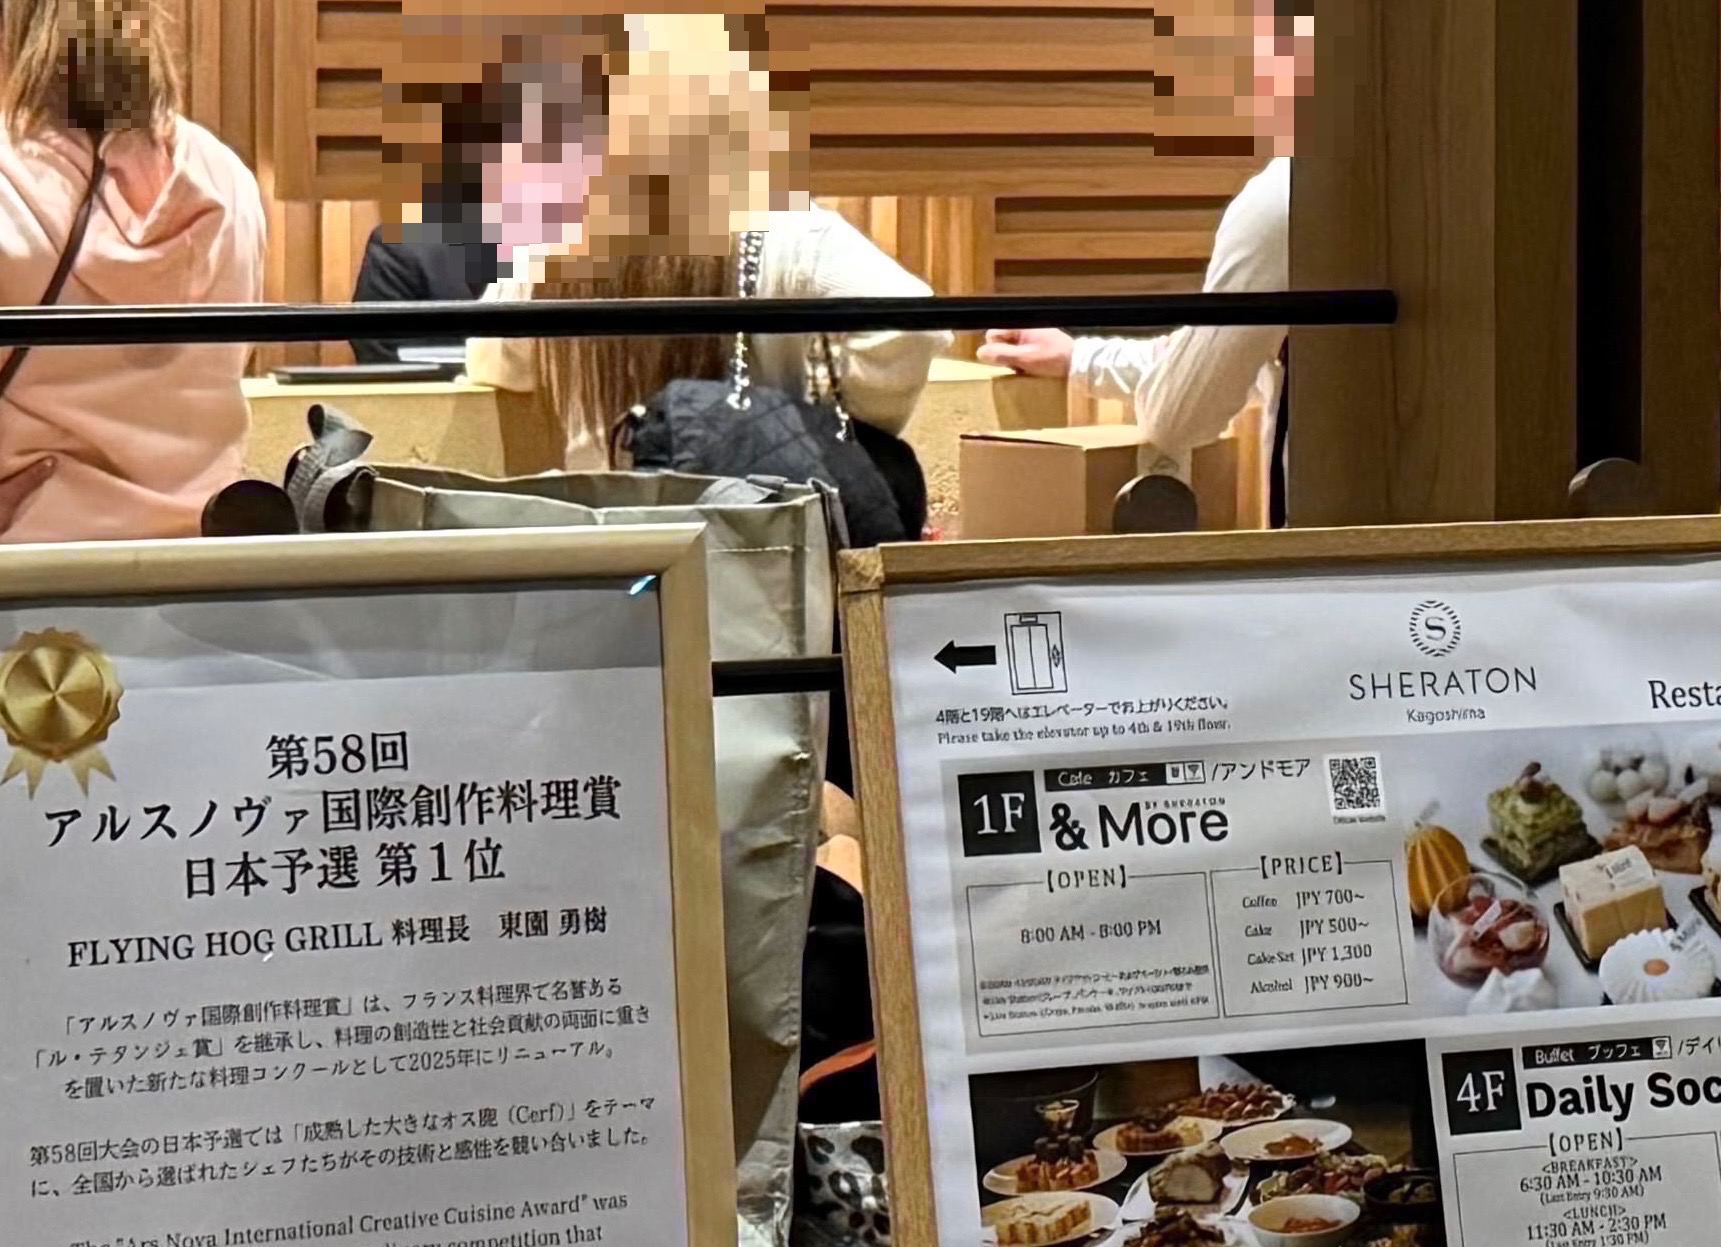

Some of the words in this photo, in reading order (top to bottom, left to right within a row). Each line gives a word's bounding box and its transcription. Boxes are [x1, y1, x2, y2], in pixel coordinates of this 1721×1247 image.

[1350, 665, 1537, 701] SHERATON
[1406, 706, 1486, 726] Kagoshima
[937, 729, 979, 745] Please
[981, 728, 1011, 742] take
[1013, 726, 1035, 741] the
[1037, 725, 1091, 739] elevator
[1093, 726, 1110, 740] up
[1112, 724, 1126, 737] to
[1128, 721, 1150, 735] 4th
[1166, 718, 1195, 733] 19th
[265, 730, 410, 780] 第58回
[1107, 768, 1150, 785] カフェ
[44, 774, 622, 848] アルスノヴァ国際創作料理賞
[972, 791, 1026, 836] 1F
[1049, 802, 1090, 851] &
[1098, 801, 1229, 849] More
[185, 843, 361, 900] 日本予選
[375, 836, 506, 888] 第1位
[1242, 894, 1278, 908] Coffee
[1296, 890, 1321, 909] JPY
[67, 933, 195, 968] FLYING
[204, 928, 275, 958] HOG
[284, 921, 383, 953] GRILL
[391, 913, 471, 947] 料理長
[558, 905, 608, 936] 勇樹
[1020, 926, 1055, 944] 8:00
[1059, 924, 1085, 942] AM
[1099, 922, 1134, 939] 8:00
[1138, 918, 1162, 937] PM
[1244, 923, 1273, 938] Cake
[1299, 919, 1325, 939] JPY
[1247, 951, 1276, 966] Cake
[1301, 946, 1327, 966] JPY
[1332, 943, 1372, 962] 1,300
[1304, 974, 1330, 994] JPY
[1534, 1048, 1575, 1065] Buffet
[1456, 1070, 1505, 1113] 4F
[1525, 1073, 1634, 1122] Daily
[1520, 1175, 1552, 1193] 6:30
[1556, 1172, 1580, 1190] AM
[1594, 1168, 1634, 1186] 10:30
[1639, 1164, 1662, 1182] AM
[167, 1233, 217, 1247] Nova
[224, 1214, 354, 1246] International
[360, 1209, 440, 1234] Creative
[443, 1202, 516, 1226] Cuisine
[593, 1193, 628, 1211] was
[1527, 1221, 1567, 1241] 11:30
[1571, 1219, 1595, 1237] AM
[1608, 1215, 1640, 1233] 2:30
[1644, 1212, 1667, 1230] PM
[448, 1228, 559, 1247] competition
[566, 1225, 603, 1243] that
